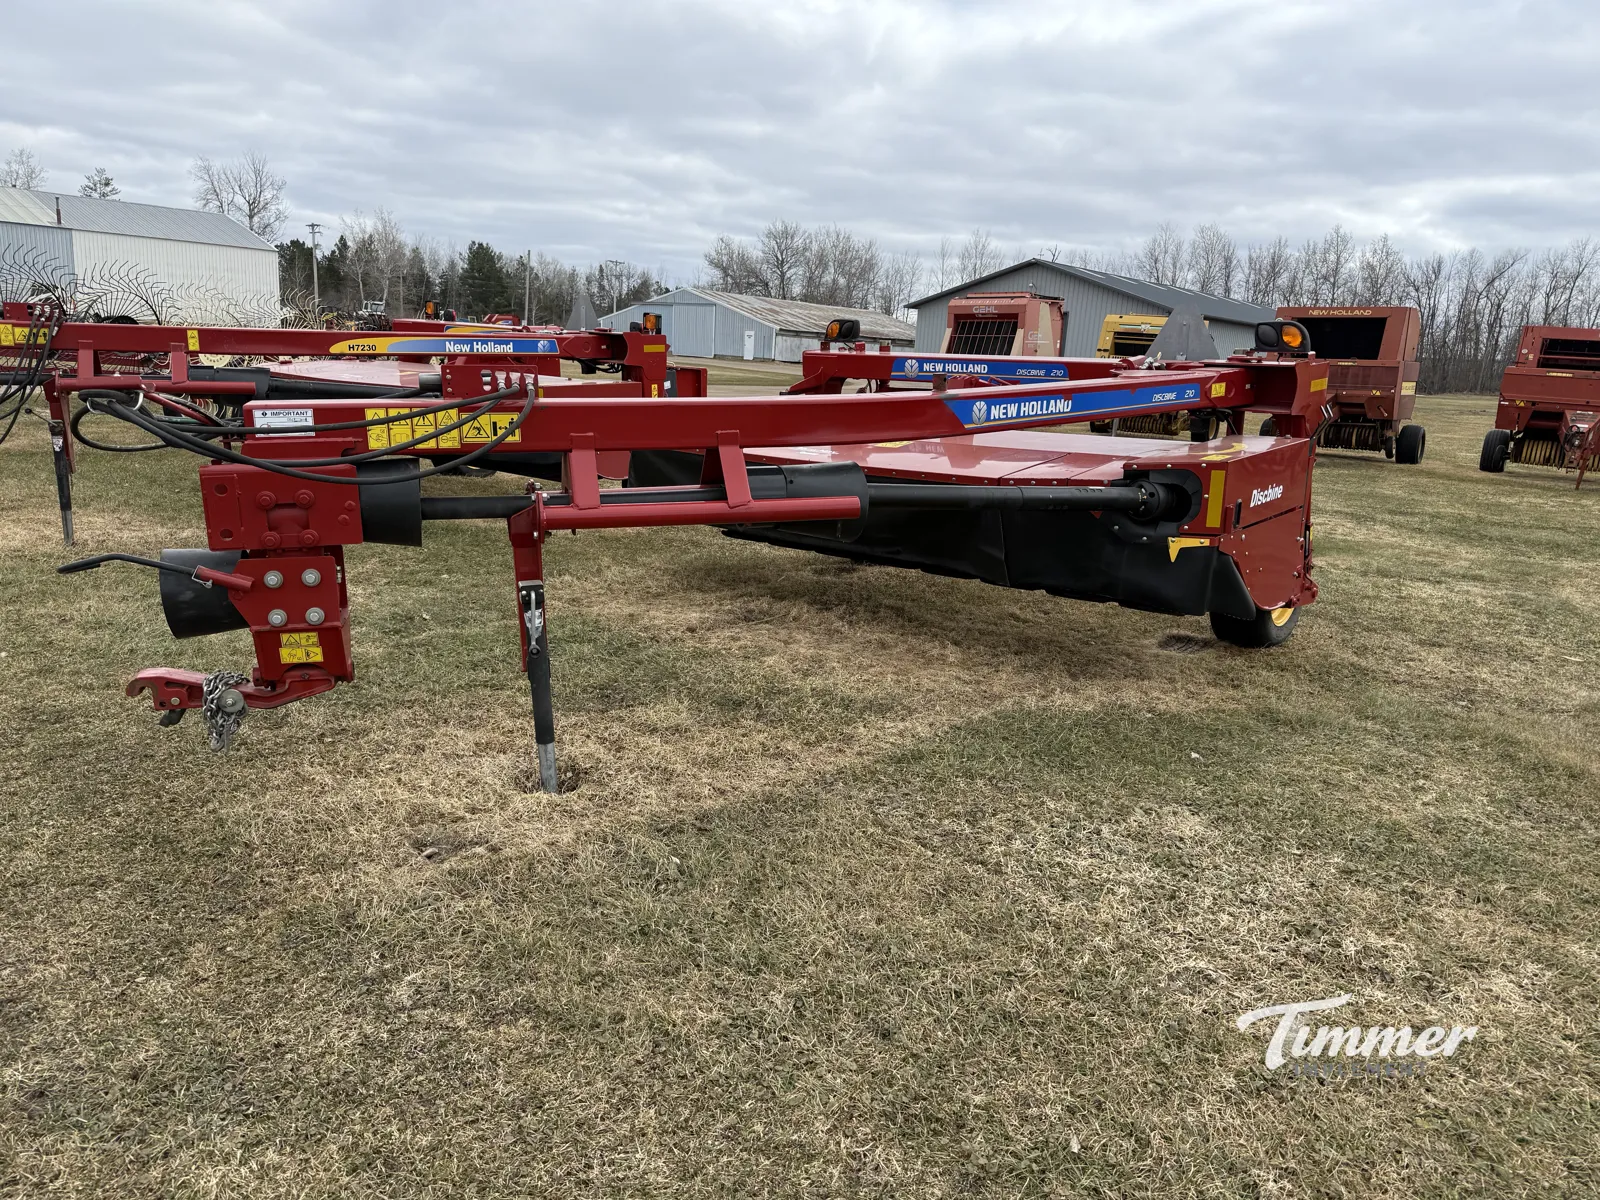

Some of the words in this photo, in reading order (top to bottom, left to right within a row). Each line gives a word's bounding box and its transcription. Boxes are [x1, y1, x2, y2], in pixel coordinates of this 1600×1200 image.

[348, 344, 377, 352] H7230
[445, 341, 470, 353] New
[473, 341, 513, 353] Holland
[923, 363, 943, 372] NEW
[946, 363, 988, 374] HOLLAND
[1050, 369, 1064, 377] 210
[1184, 389, 1195, 398] 210
[990, 403, 1018, 420] NEW
[1020, 399, 1072, 416] HOLLAND
[1249, 483, 1284, 508] Discbine
